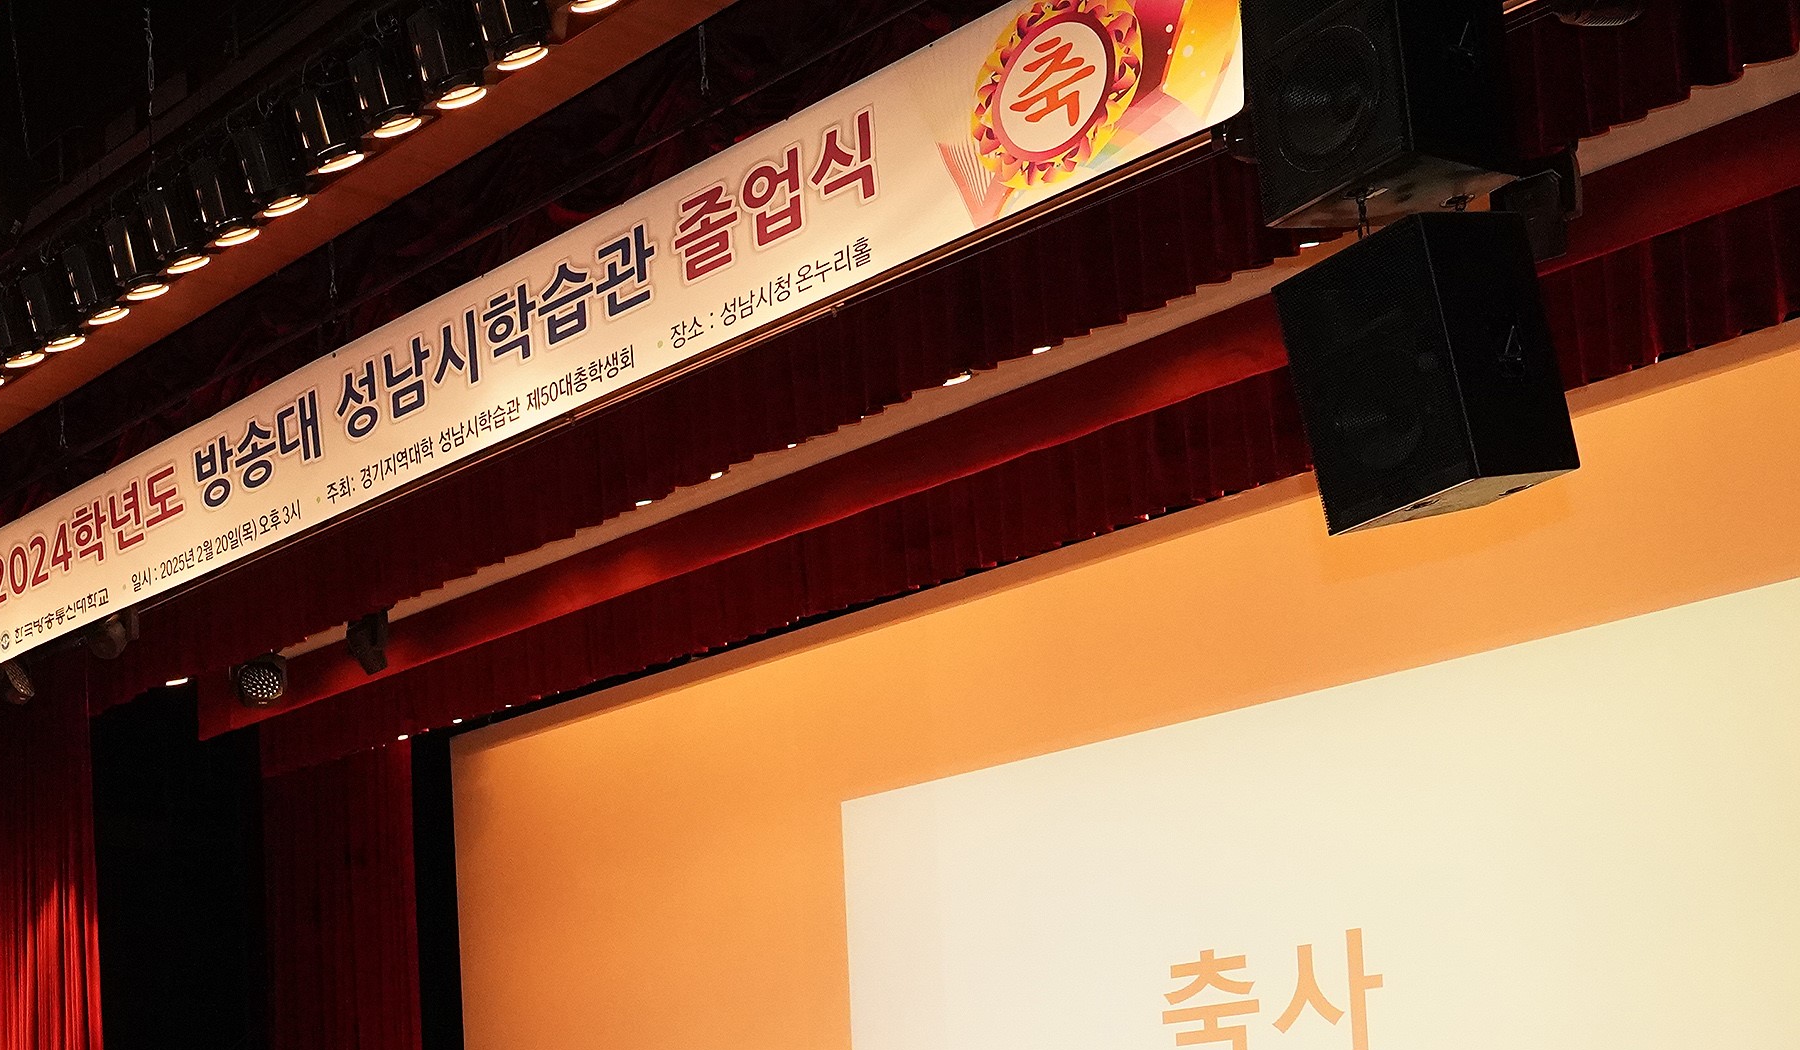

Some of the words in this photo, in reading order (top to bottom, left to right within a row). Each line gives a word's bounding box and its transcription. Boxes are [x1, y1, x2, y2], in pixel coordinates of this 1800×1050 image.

[1008, 34, 1096, 127] 축
[193, 389, 323, 509] 방송대
[336, 224, 655, 439] 성남시학습관
[674, 109, 876, 282] 졸업식
[670, 316, 705, 349] 장소
[719, 273, 792, 327] 성남시청
[795, 236, 873, 293] 온누리홀
[359, 436, 434, 490] 경기지역대학
[437, 396, 521, 453] 성남시학습관
[526, 344, 636, 412] 제50대총학생회
[160, 547, 195, 580] 2025년
[196, 538, 214, 563] 2월
[215, 518, 258, 556] 20일(목)
[259, 508, 282, 536] 오후
[282, 498, 302, 525] 3시
